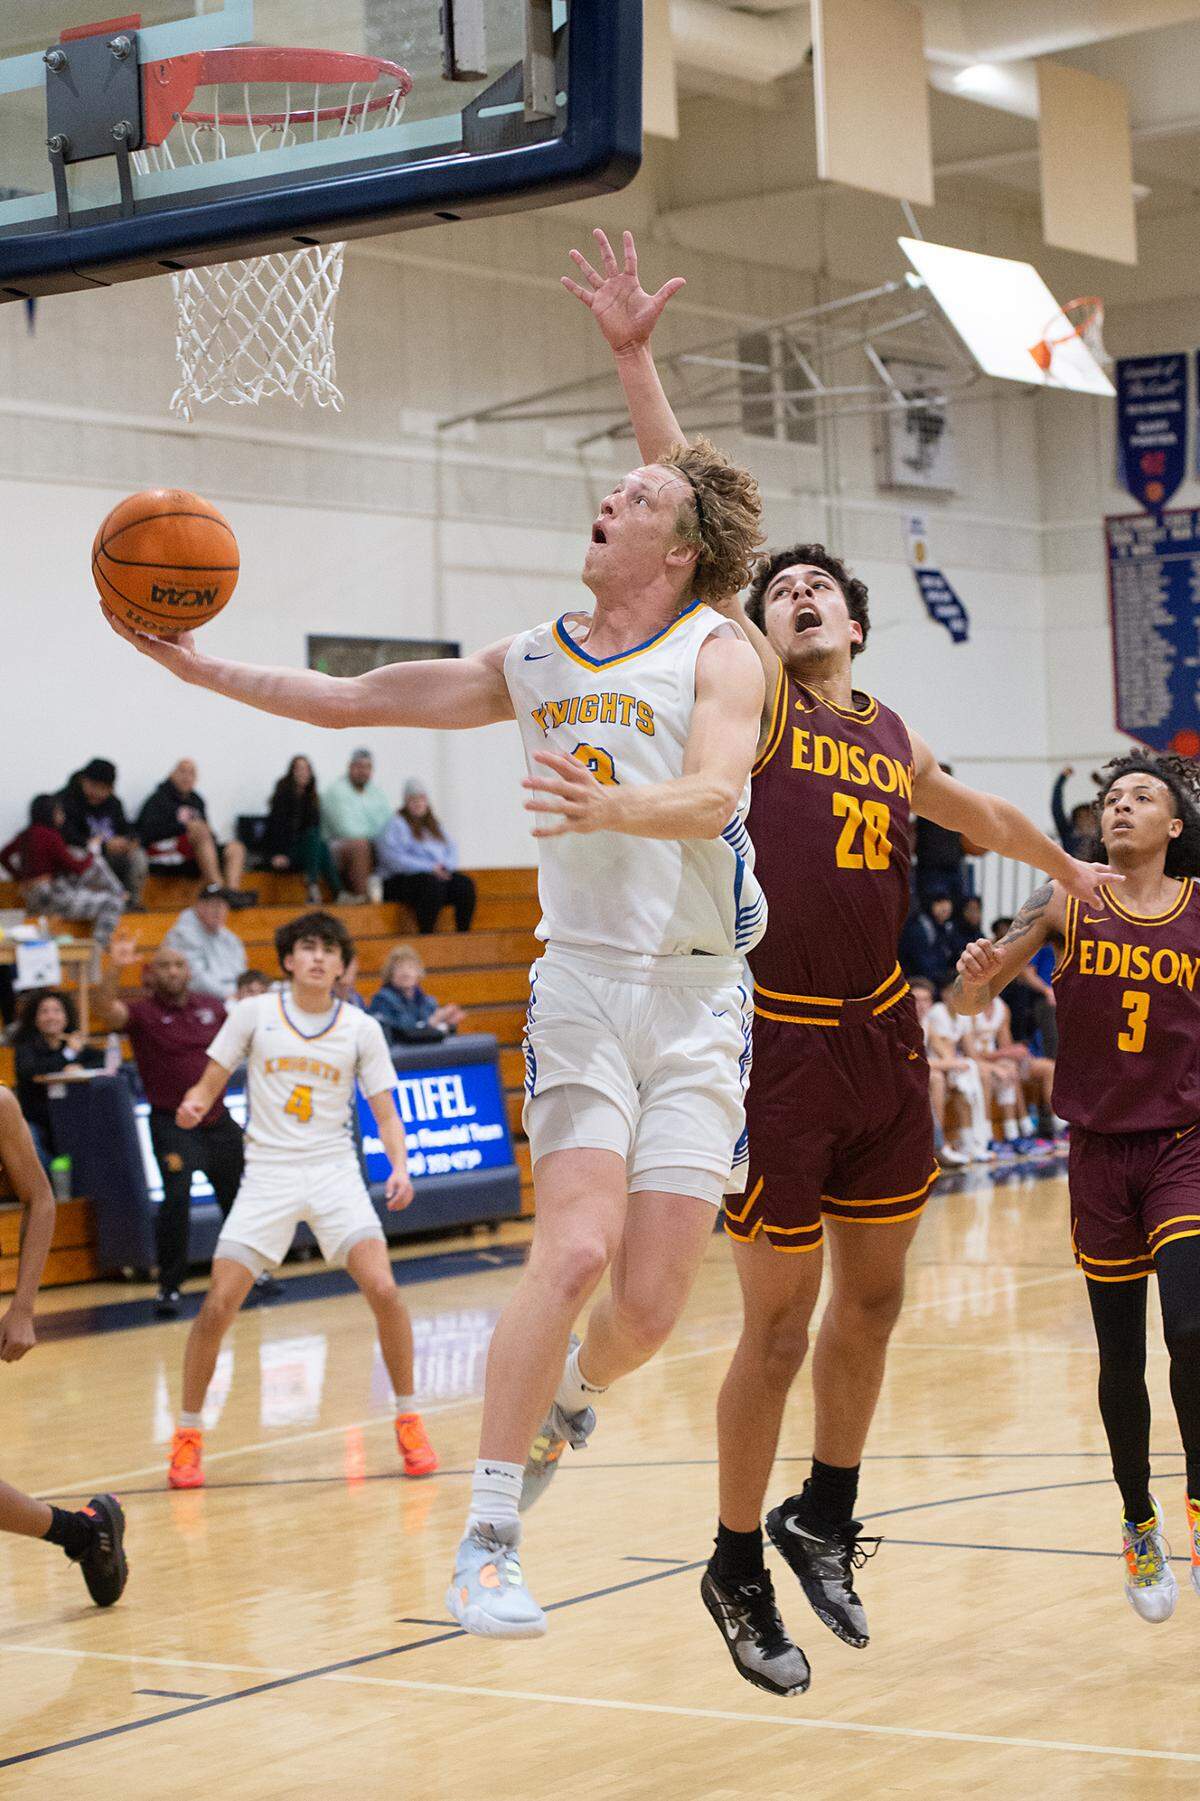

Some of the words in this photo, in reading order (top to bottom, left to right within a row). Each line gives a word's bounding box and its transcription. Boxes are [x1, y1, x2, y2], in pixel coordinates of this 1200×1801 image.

[151, 585, 219, 606] NCAA
[531, 692, 656, 739] KNIGHTS
[791, 726, 914, 804] EDISON
[832, 791, 893, 870] 20
[1080, 939, 1200, 992] EDISON
[1117, 990, 1150, 1053] 3
[264, 1055, 341, 1086] KNIGHTS
[284, 1084, 314, 1124] 4
[397, 1074, 477, 1123] TIFEL
